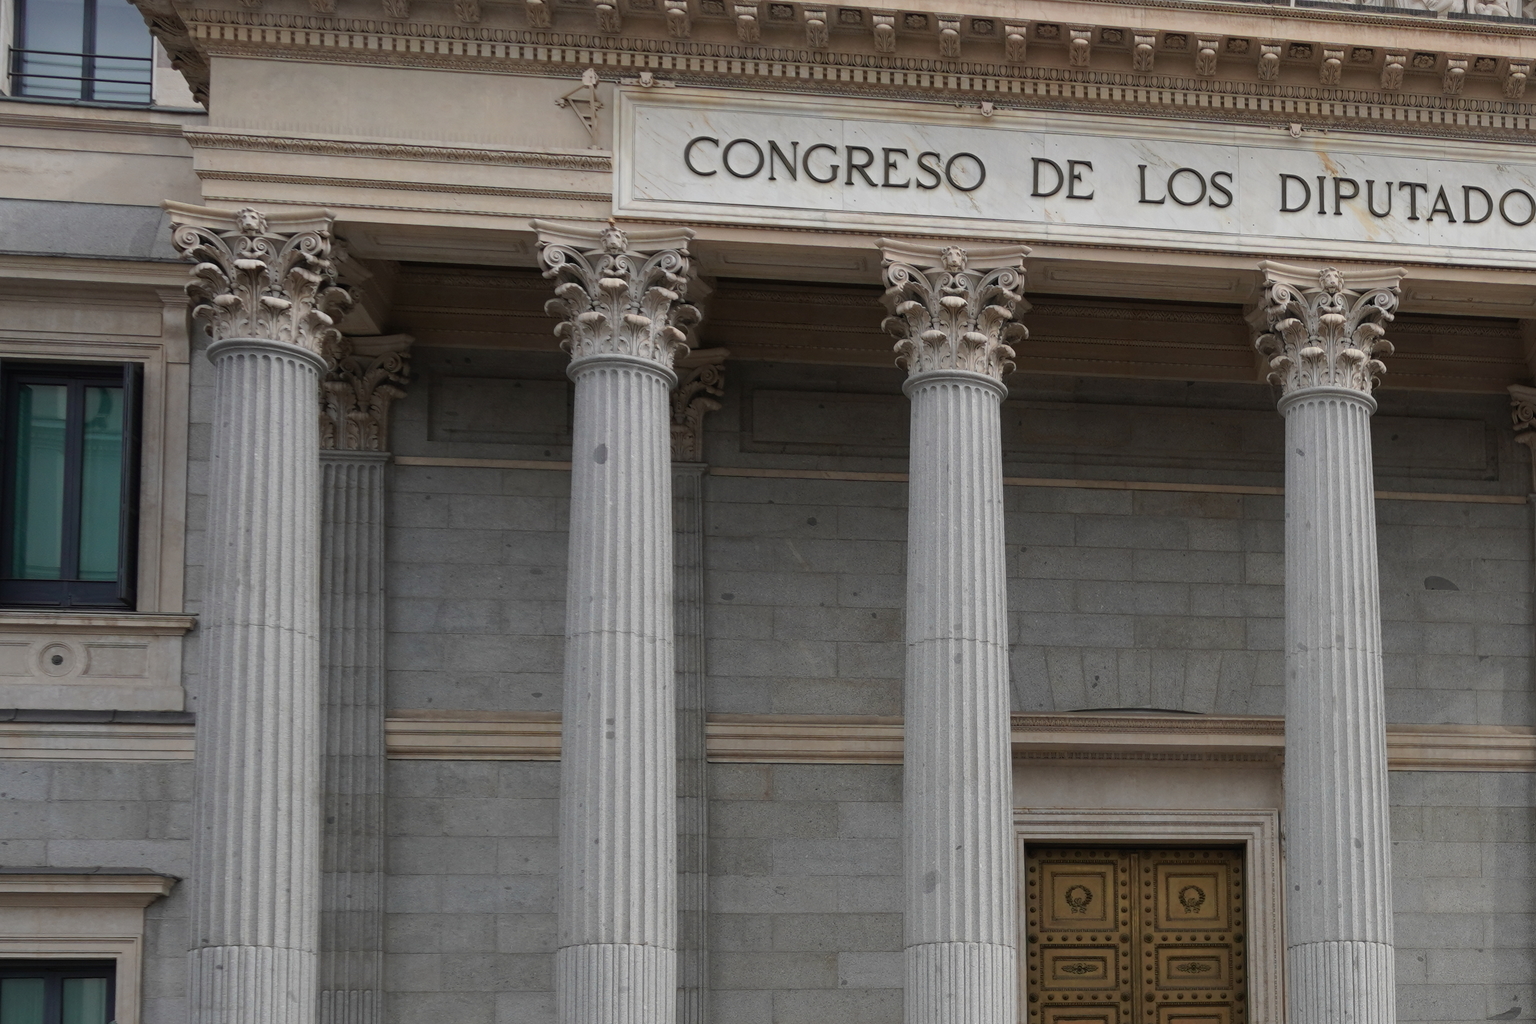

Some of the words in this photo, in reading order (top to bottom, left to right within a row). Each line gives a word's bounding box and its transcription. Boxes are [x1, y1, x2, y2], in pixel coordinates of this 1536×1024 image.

[683, 135, 985, 193] CONGRESO
[1031, 157, 1094, 200] DE
[1139, 164, 1233, 208] LOS
